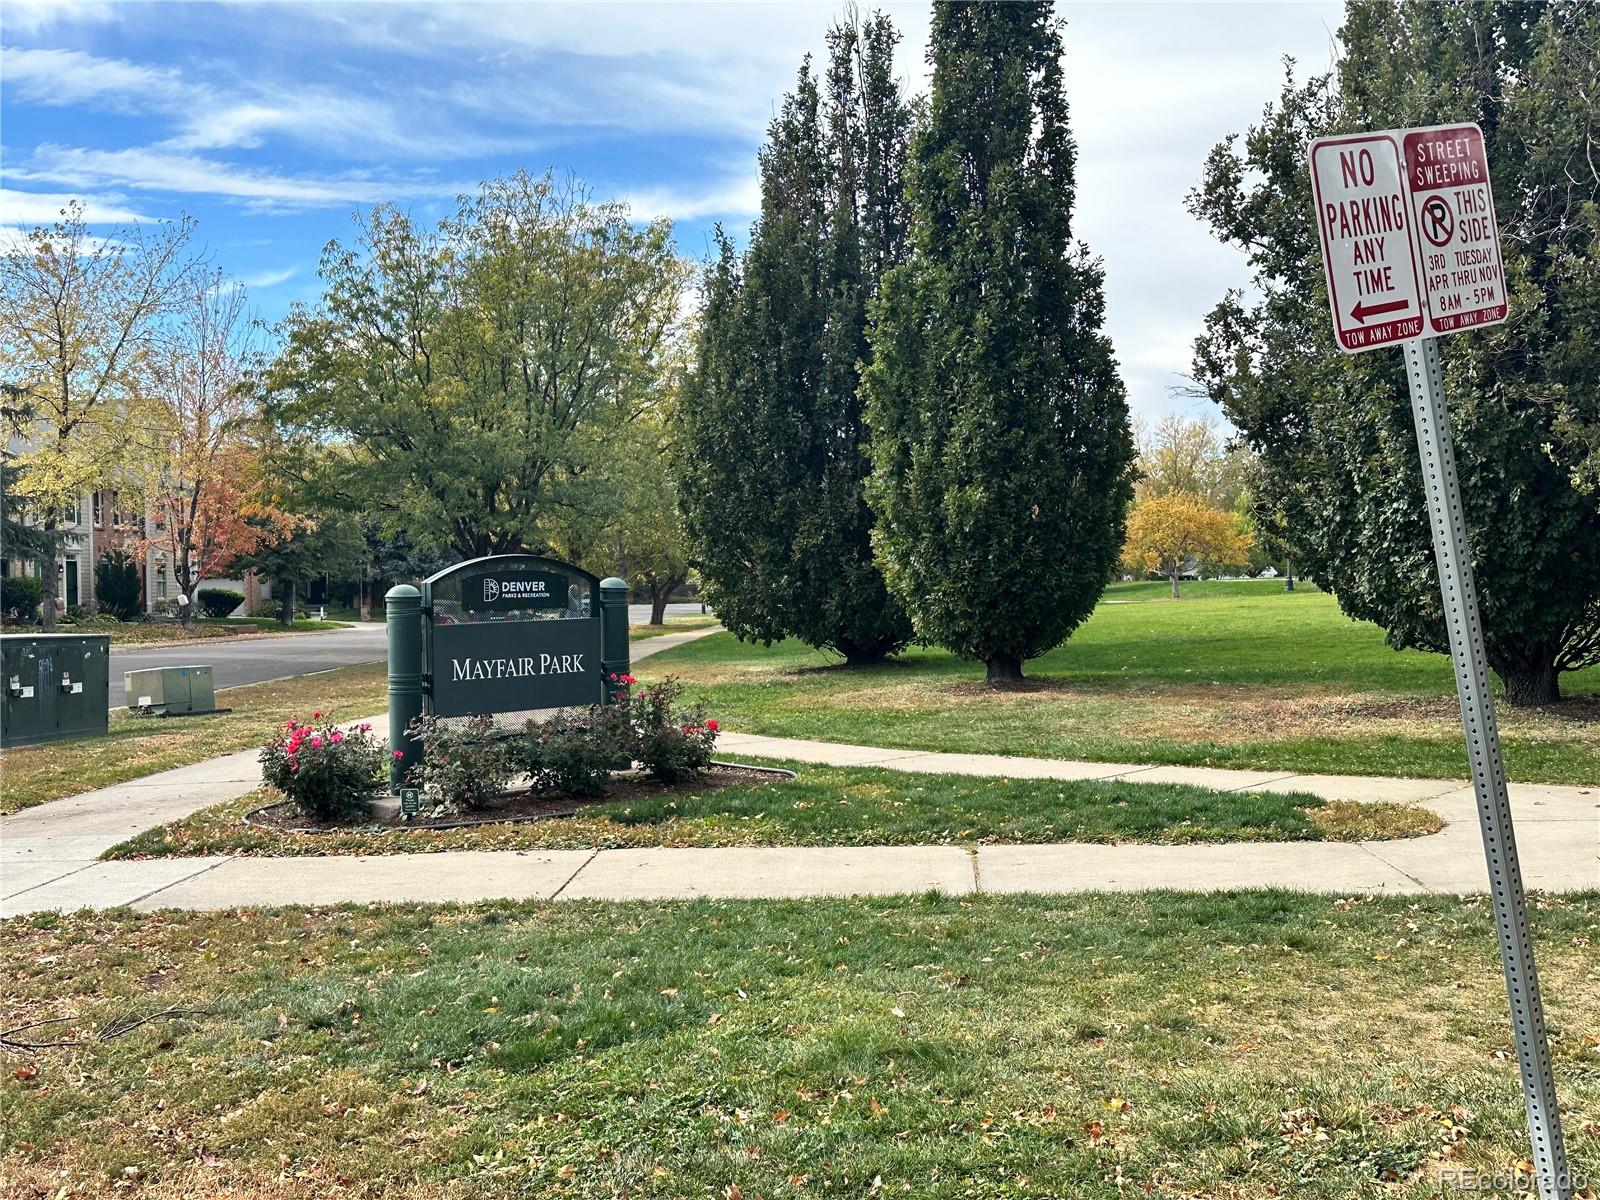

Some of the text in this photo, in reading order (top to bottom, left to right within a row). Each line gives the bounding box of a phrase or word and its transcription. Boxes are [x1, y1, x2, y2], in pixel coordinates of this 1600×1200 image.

[1417, 138, 1471, 162] STREET
[1339, 149, 1375, 189] NO
[1416, 160, 1480, 186] SWEEPING
[1454, 188, 1487, 215] THIS
[1326, 194, 1404, 240] PARKING
[1459, 216, 1491, 244] SIDE
[1353, 237, 1385, 266] ANY
[1428, 247, 1492, 271] 3RD TUESDAY
[1353, 266, 1395, 296] TIME
[1429, 264, 1499, 292] APR THRU NOV
[1439, 307, 1501, 330] TOW AWAY ZONE
[1345, 320, 1420, 347] TOW AWAY ZONE
[501, 581, 546, 592] DENVER
[452, 653, 585, 681] MAYFAIR PARK
